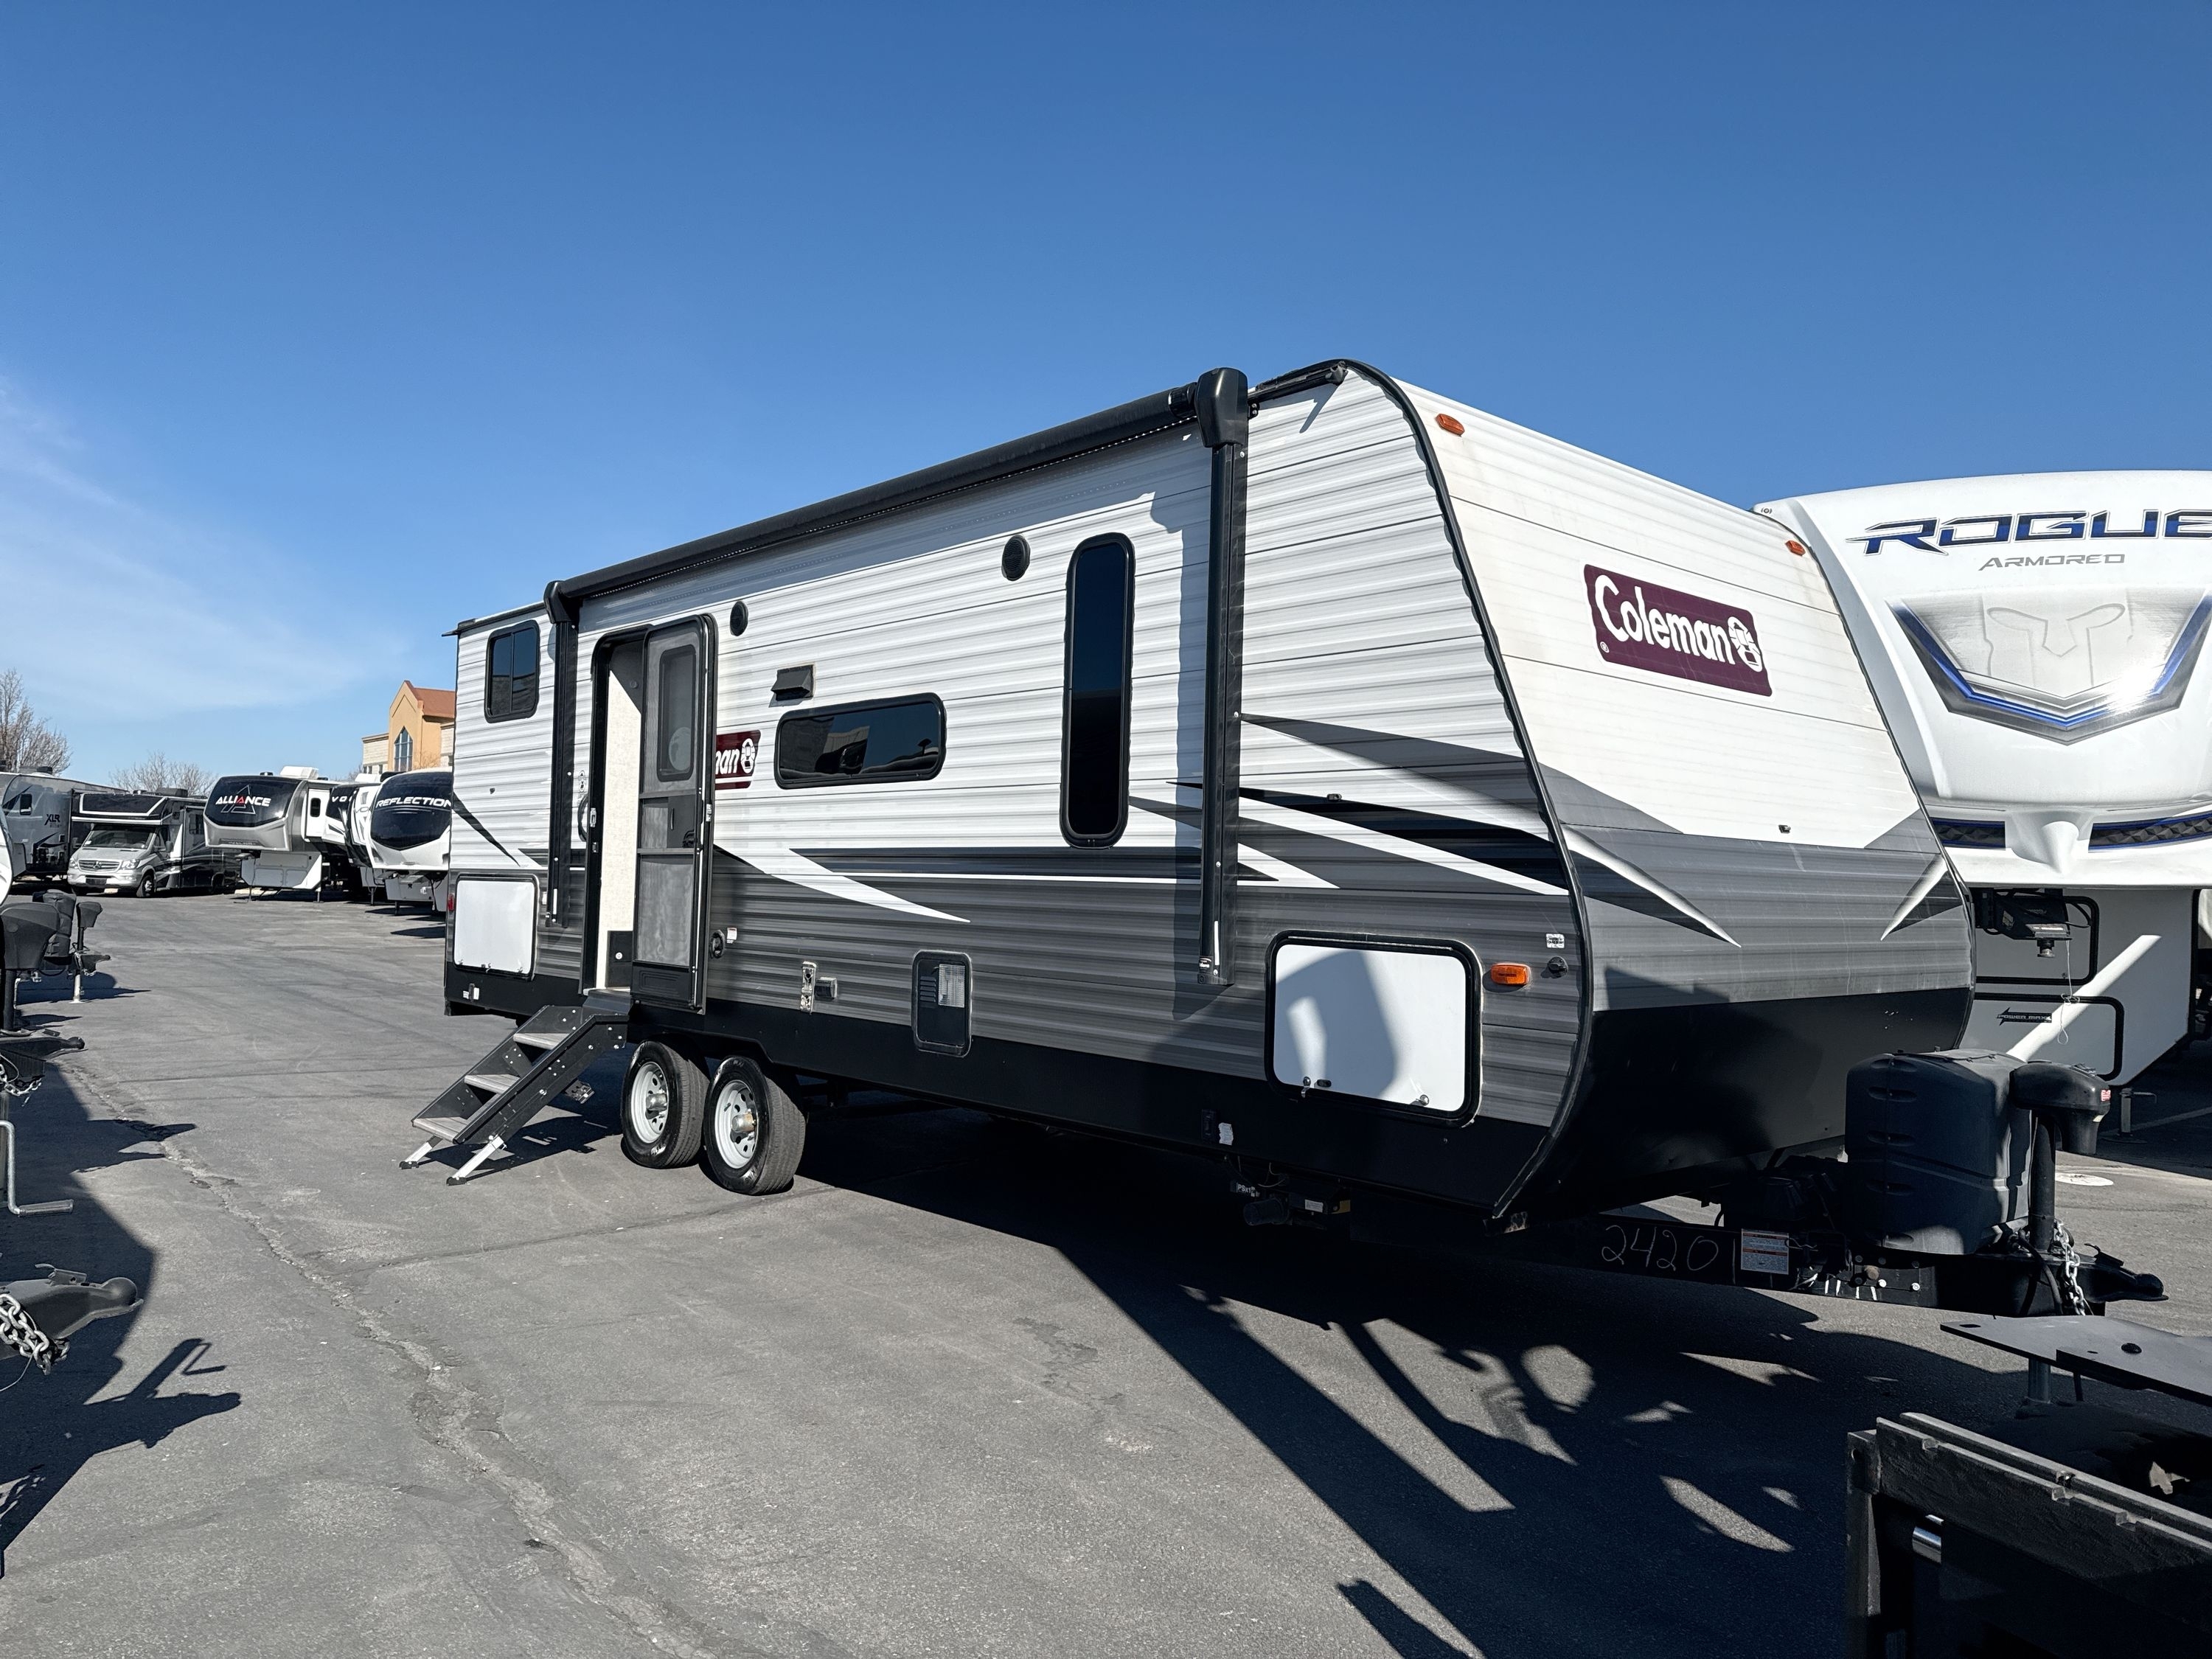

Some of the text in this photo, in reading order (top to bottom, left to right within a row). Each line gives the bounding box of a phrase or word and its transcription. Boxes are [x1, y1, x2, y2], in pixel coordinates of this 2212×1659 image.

[1846, 509, 2212, 556] ROGUE
[1978, 554, 2125, 571] ARMORED
[1595, 574, 1736, 665] Coleman
[215, 795, 271, 807] ALLIANCE
[376, 796, 452, 809] REFLECTION
[44, 813, 60, 826] XLR
[1601, 1225, 1719, 1271] 2420
